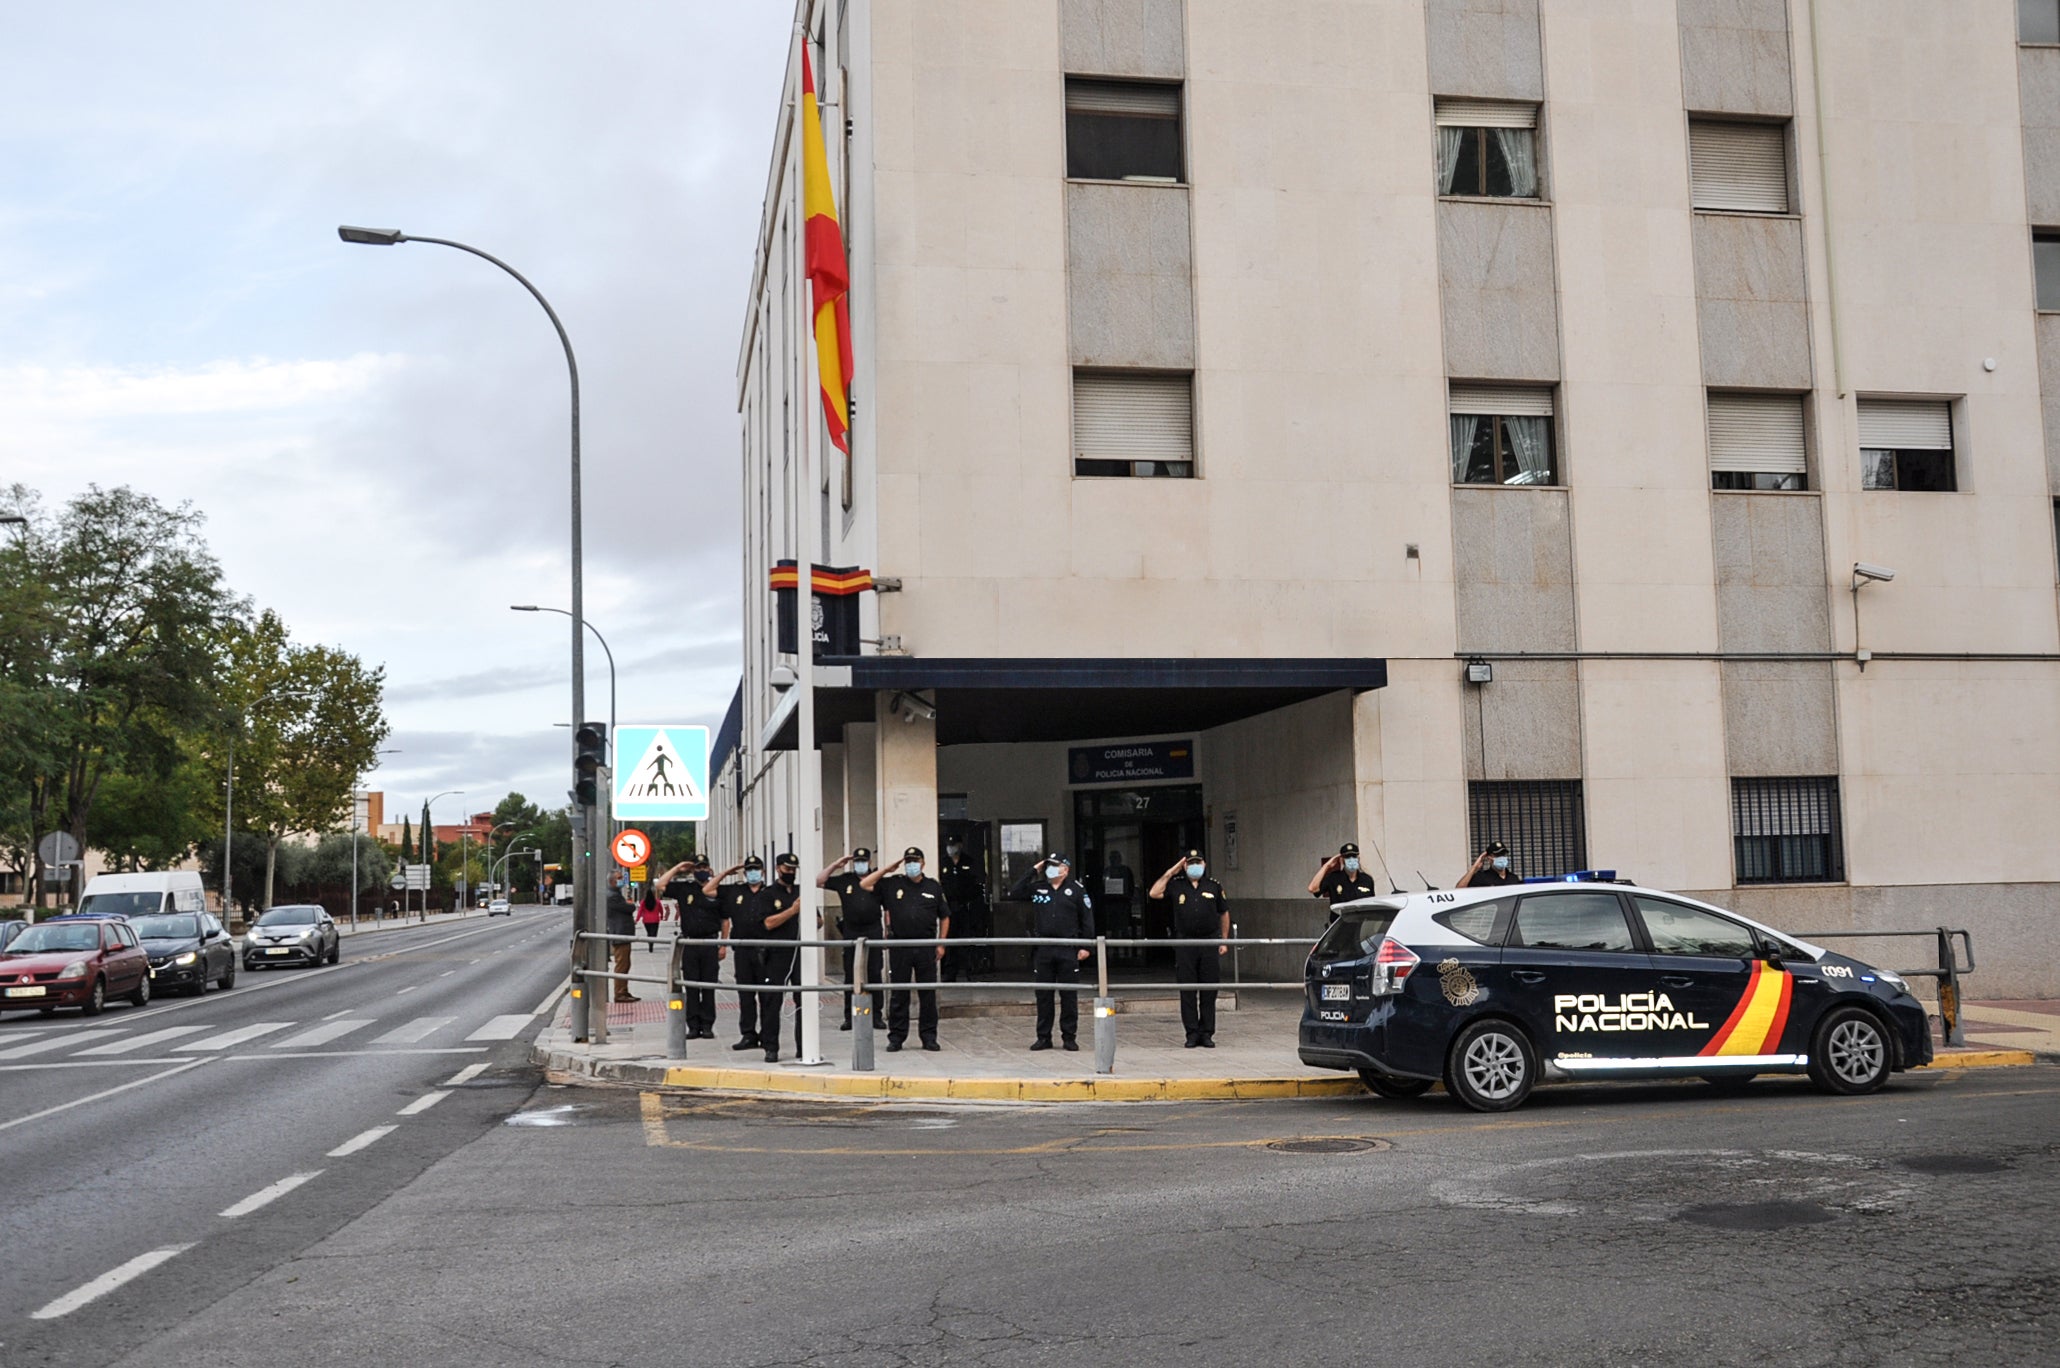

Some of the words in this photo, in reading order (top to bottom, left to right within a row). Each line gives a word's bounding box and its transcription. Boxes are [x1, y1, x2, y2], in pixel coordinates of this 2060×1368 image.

[1104, 748, 1154, 759] COMISARIA
[1125, 768, 1164, 776] NACIONAL
[1135, 797, 1150, 809] 27
[1427, 893, 1455, 903] 1AU
[1554, 990, 1674, 1014] POLICÍA
[1555, 1012, 1710, 1032] NACIONAL
